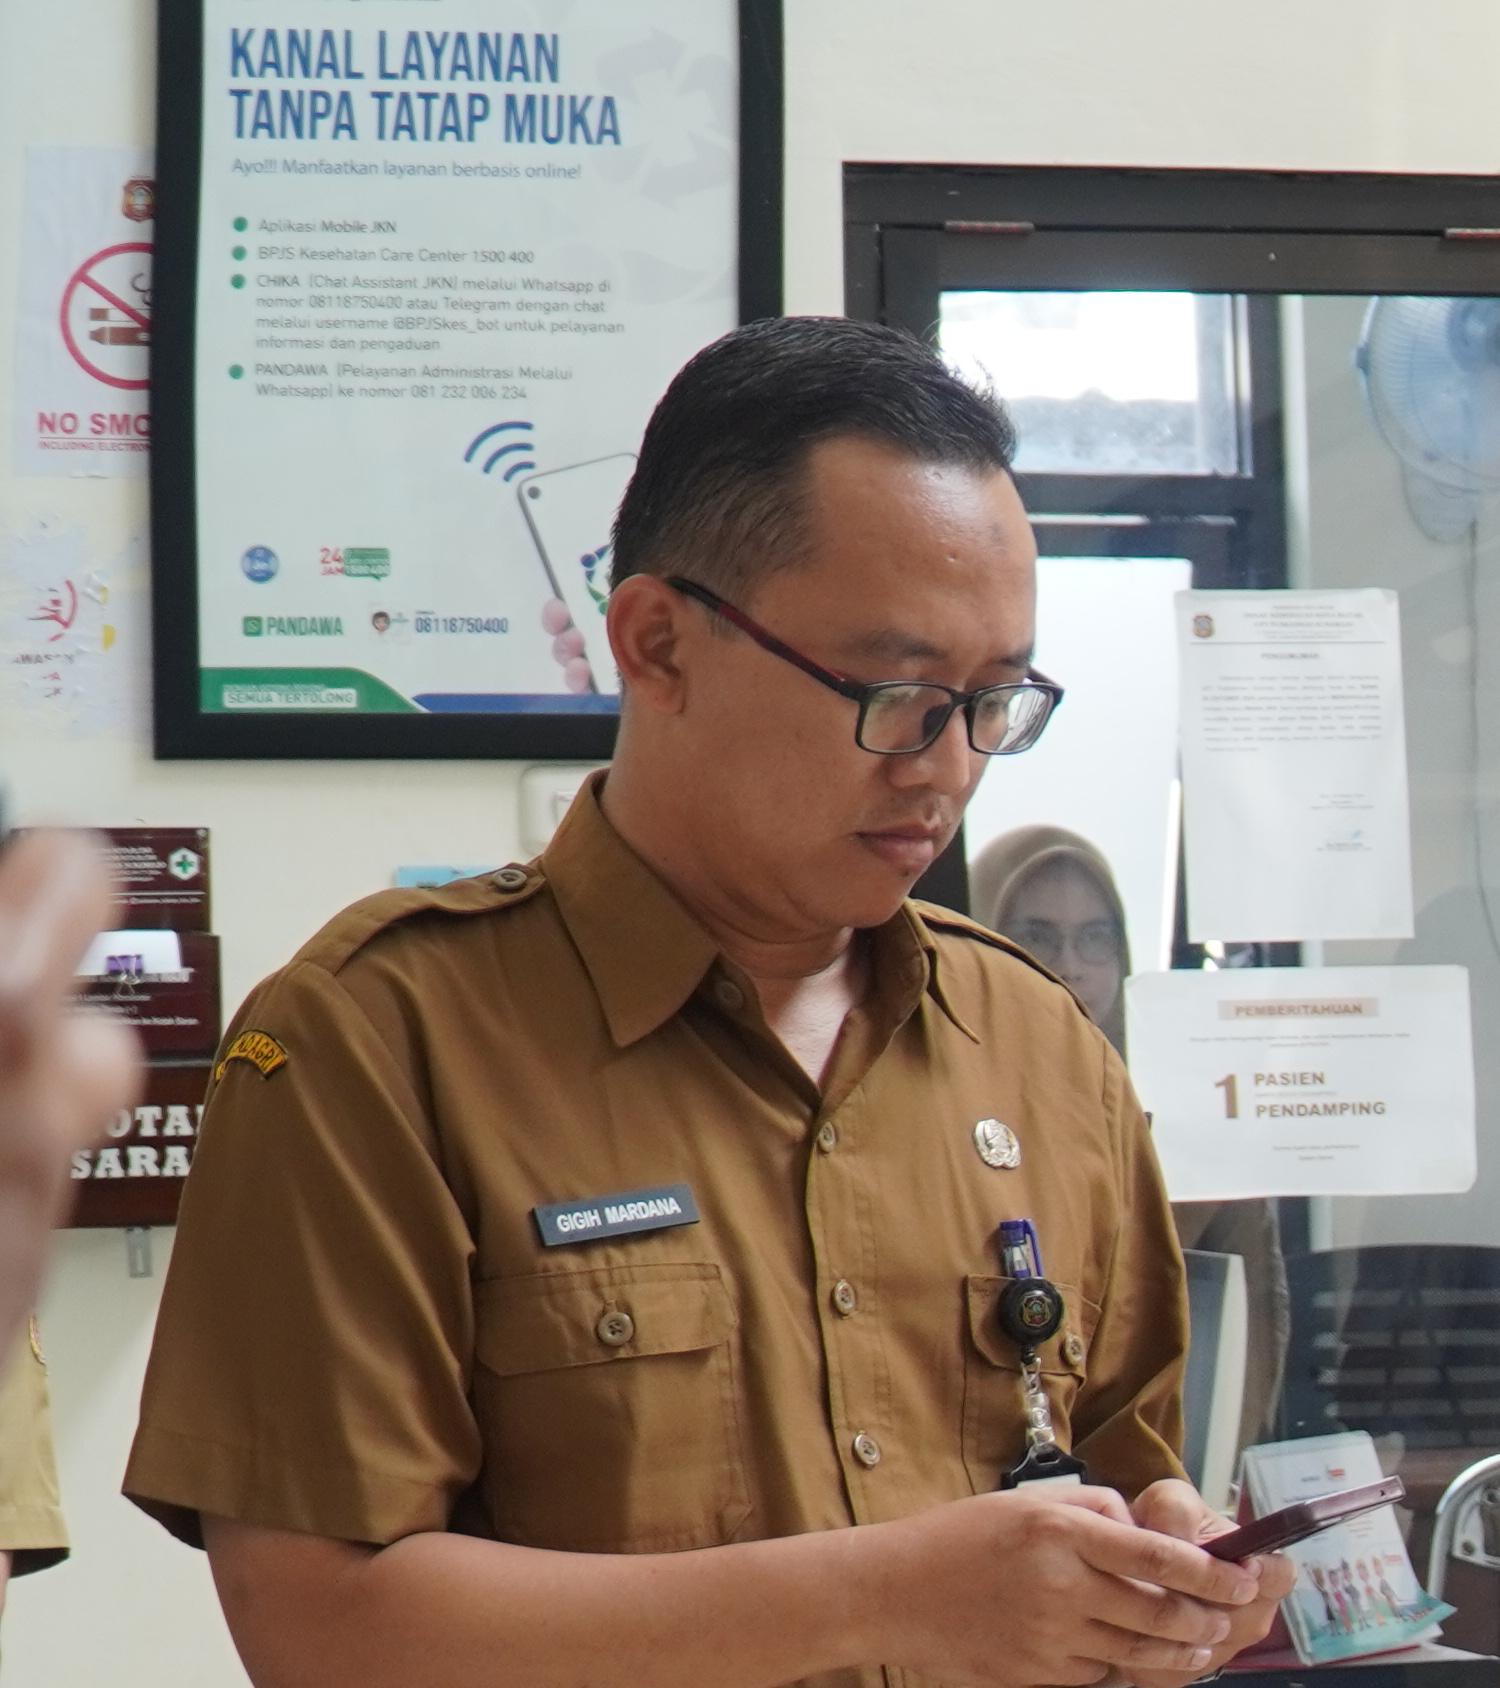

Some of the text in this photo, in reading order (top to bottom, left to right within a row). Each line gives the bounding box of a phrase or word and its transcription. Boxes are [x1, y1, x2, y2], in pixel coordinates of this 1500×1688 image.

[230, 28, 560, 83] KANAL LAYANAN
[229, 89, 622, 145] TANPA TATAP MUKA
[232, 158, 582, 180] Ayo!!! Manfaatkan layanan berbasis online!
[258, 219, 397, 234] Aplikasi Mobile JKN
[259, 246, 534, 264] BPJS Kesehatan Care Center 1500 400
[257, 274, 300, 288] CHIKA
[352, 275, 418, 289] Assistant
[463, 278, 517, 291] melalui
[522, 278, 593, 294] Whatsapp
[598, 279, 611, 292] di
[256, 297, 303, 308] nomor
[406, 298, 438, 310] atau
[444, 297, 510, 313] Telegram
[516, 299, 569, 315] dengan
[574, 300, 605, 312] chat
[256, 316, 310, 329] melalui
[316, 318, 388, 329] username
[504, 319, 545, 332] untuk
[551, 320, 625, 335] pelayanan
[256, 336, 440, 353] informasi dan pengaduan
[255, 363, 328, 376] PANDAWA
[421, 365, 514, 379] Administrasi
[519, 366, 573, 380] Melalui
[337, 384, 354, 397] ke
[359, 386, 407, 397] nomor
[411, 385, 435, 398] 081
[442, 386, 467, 399] 232
[471, 386, 497, 399] 006
[502, 387, 527, 399] 234
[38, 413, 151, 435] NO SMO
[320, 547, 342, 564] 24
[267, 617, 343, 636] PANDAWA
[228, 691, 353, 704] SEMUA TERTOLONG
[1235, 1003, 1363, 1017] PEMBERITAHUAN
[1214, 1071, 1325, 1119] 1 PASIEN
[1256, 1101, 1387, 1118] PENDAMPING
[556, 1197, 682, 1233] GIGIH MARDANA
